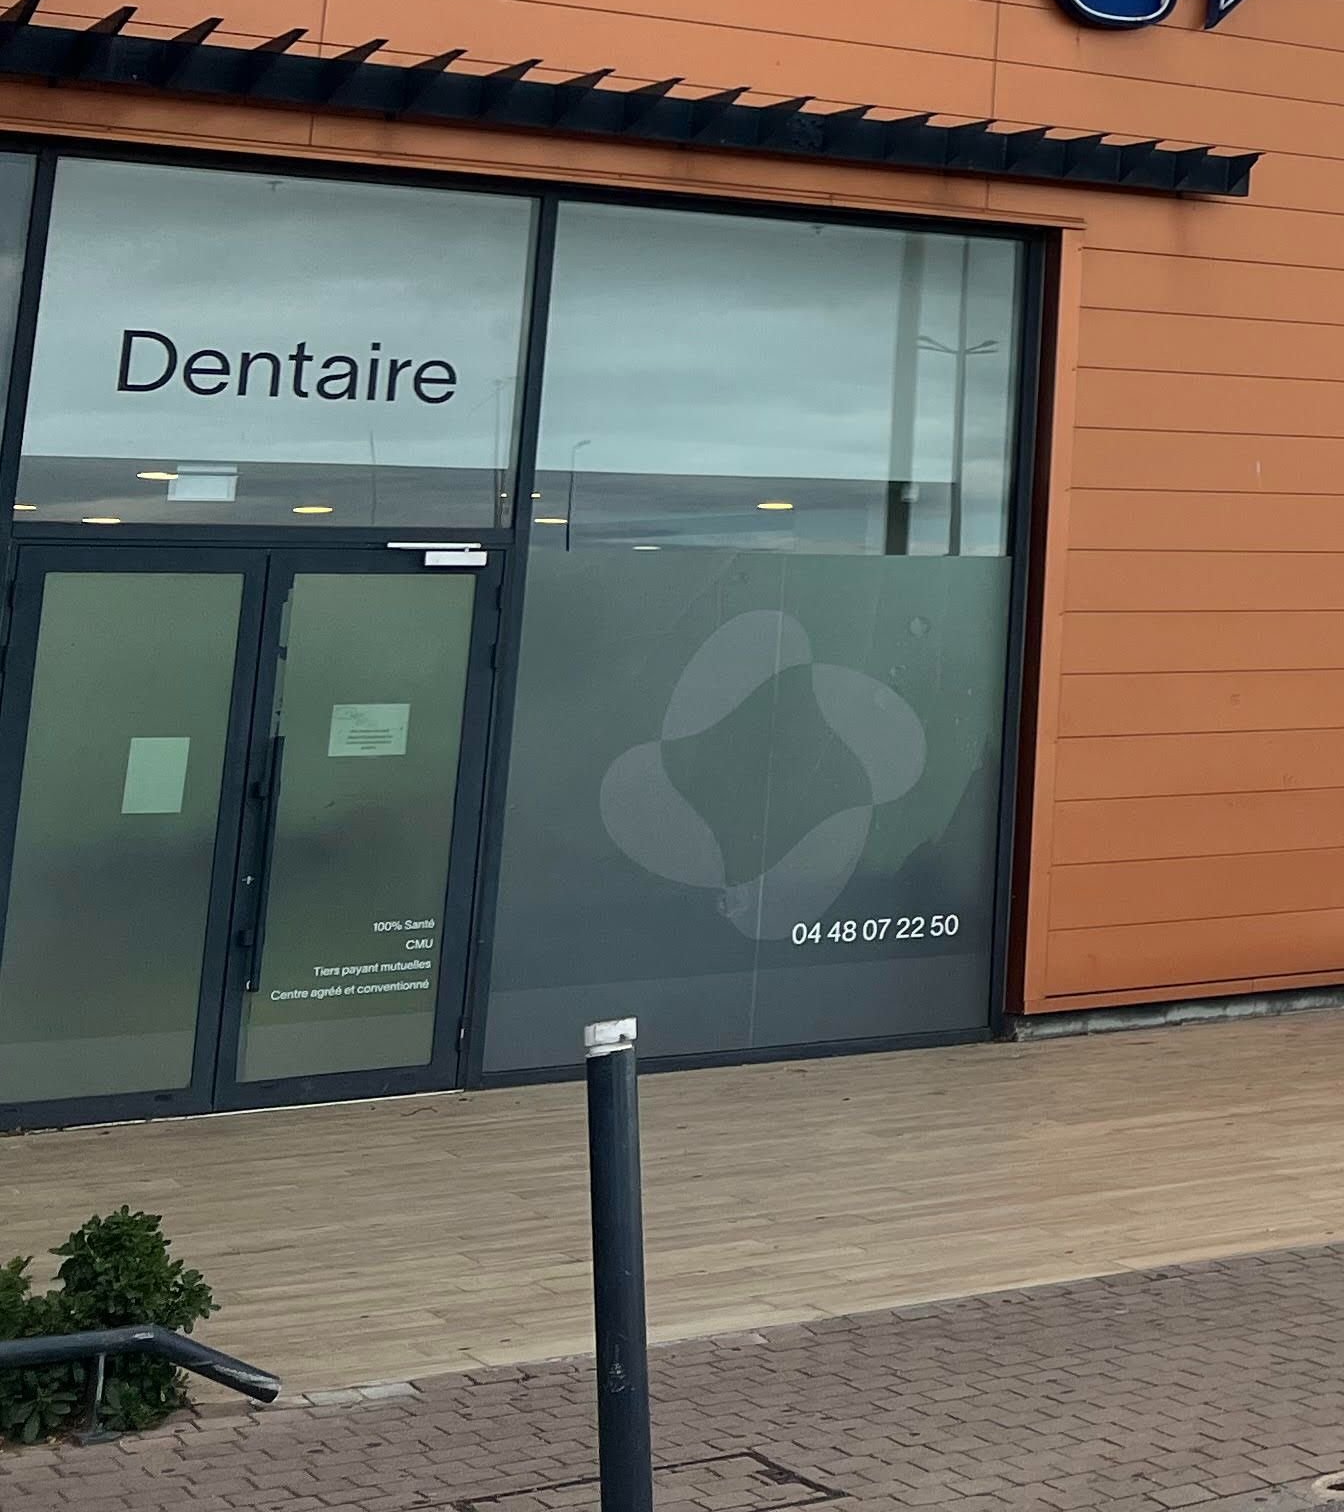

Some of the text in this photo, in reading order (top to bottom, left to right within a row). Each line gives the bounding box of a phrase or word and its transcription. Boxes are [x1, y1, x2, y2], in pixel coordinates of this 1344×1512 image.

[116, 329, 457, 404] Dentaire
[373, 918, 435, 932] 100% Santé
[791, 914, 959, 945] 04 48 07 22 50
[405, 938, 434, 950] CMU
[313, 959, 432, 977] Tiers payant mutuelles
[270, 989, 309, 1001] Centre
[344, 985, 355, 995] et
[357, 978, 430, 994] conventionné
